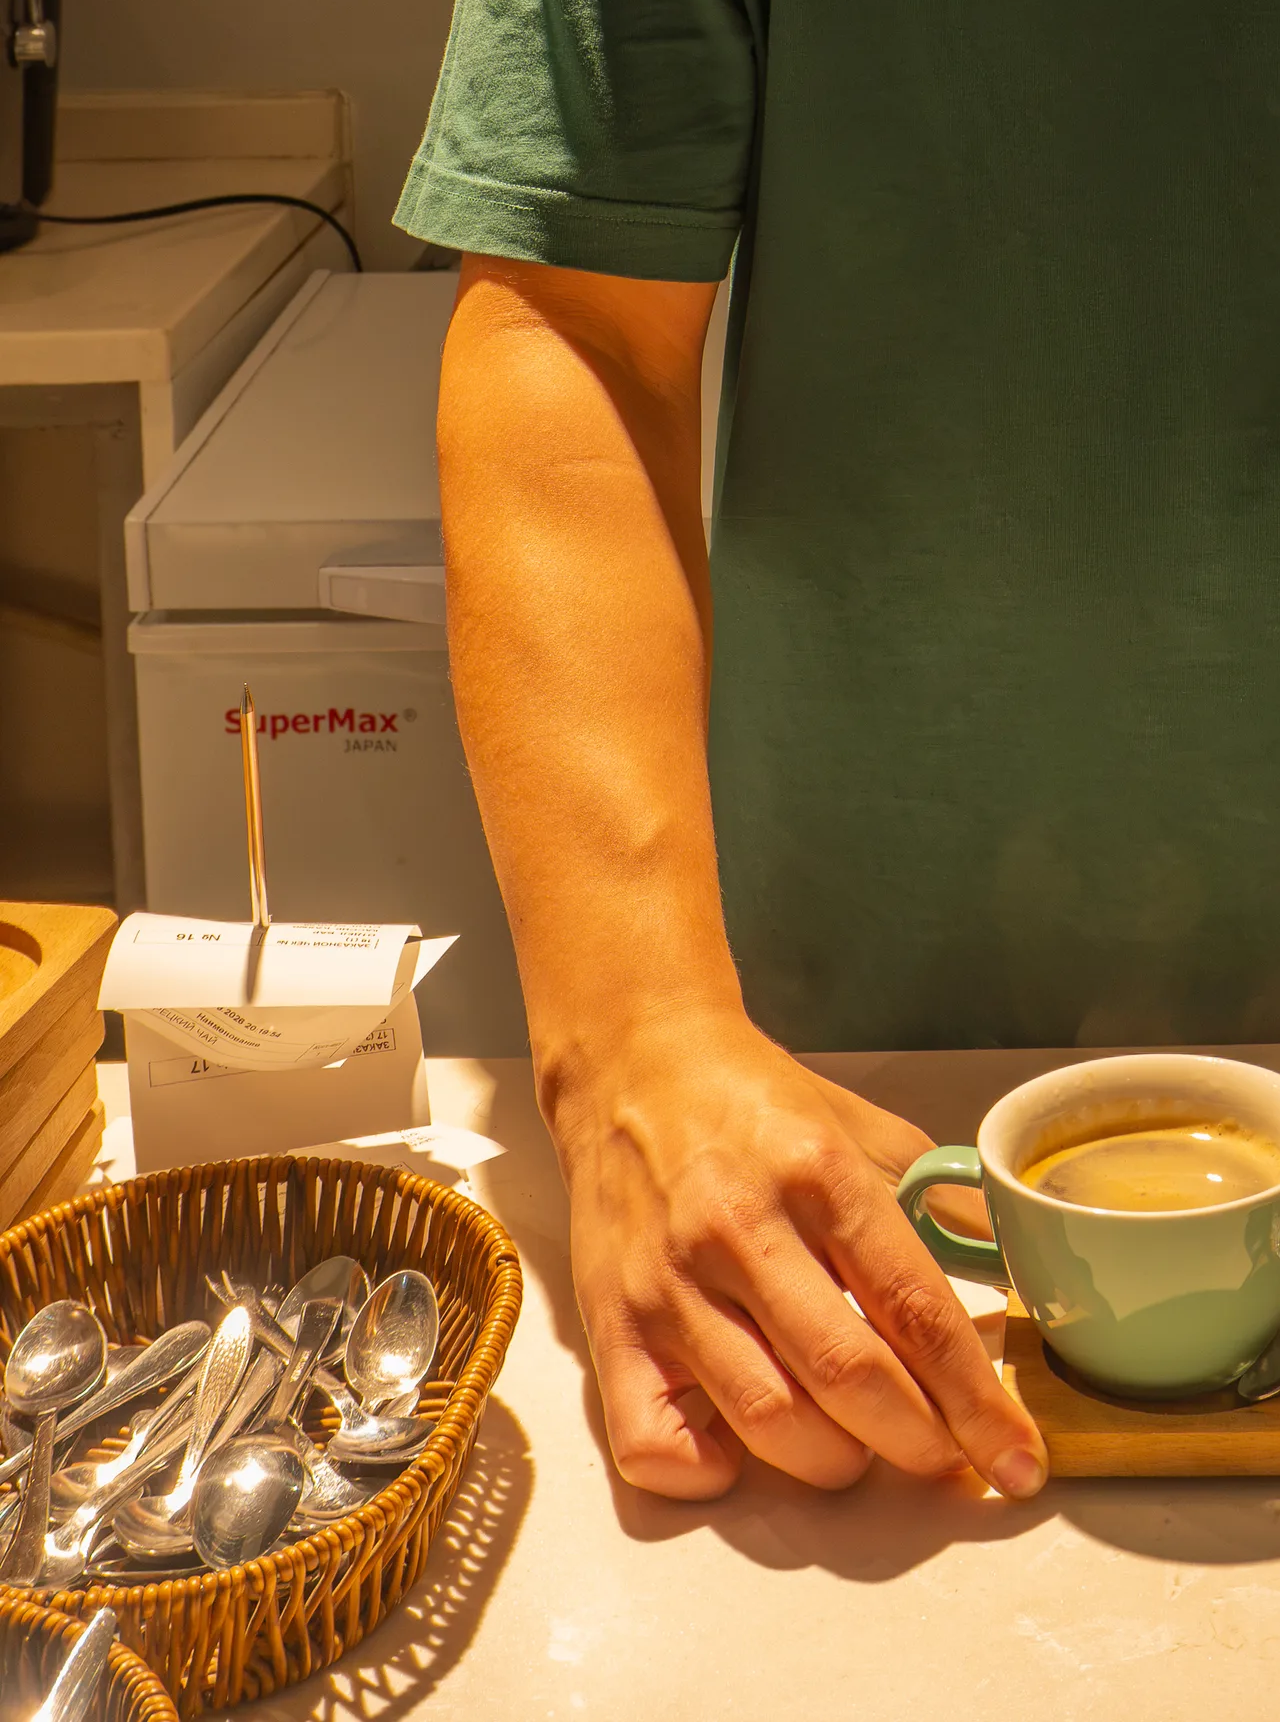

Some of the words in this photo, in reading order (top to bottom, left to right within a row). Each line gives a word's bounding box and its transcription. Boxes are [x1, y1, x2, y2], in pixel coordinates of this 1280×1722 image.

[343, 739, 397, 753] JAPAN
[176, 933, 194, 942] 16
[196, 1028, 218, 1045] ЧАЙ
[353, 1041, 389, 1054] ЗАКАЗ
[191, 1059, 210, 1074] 17
